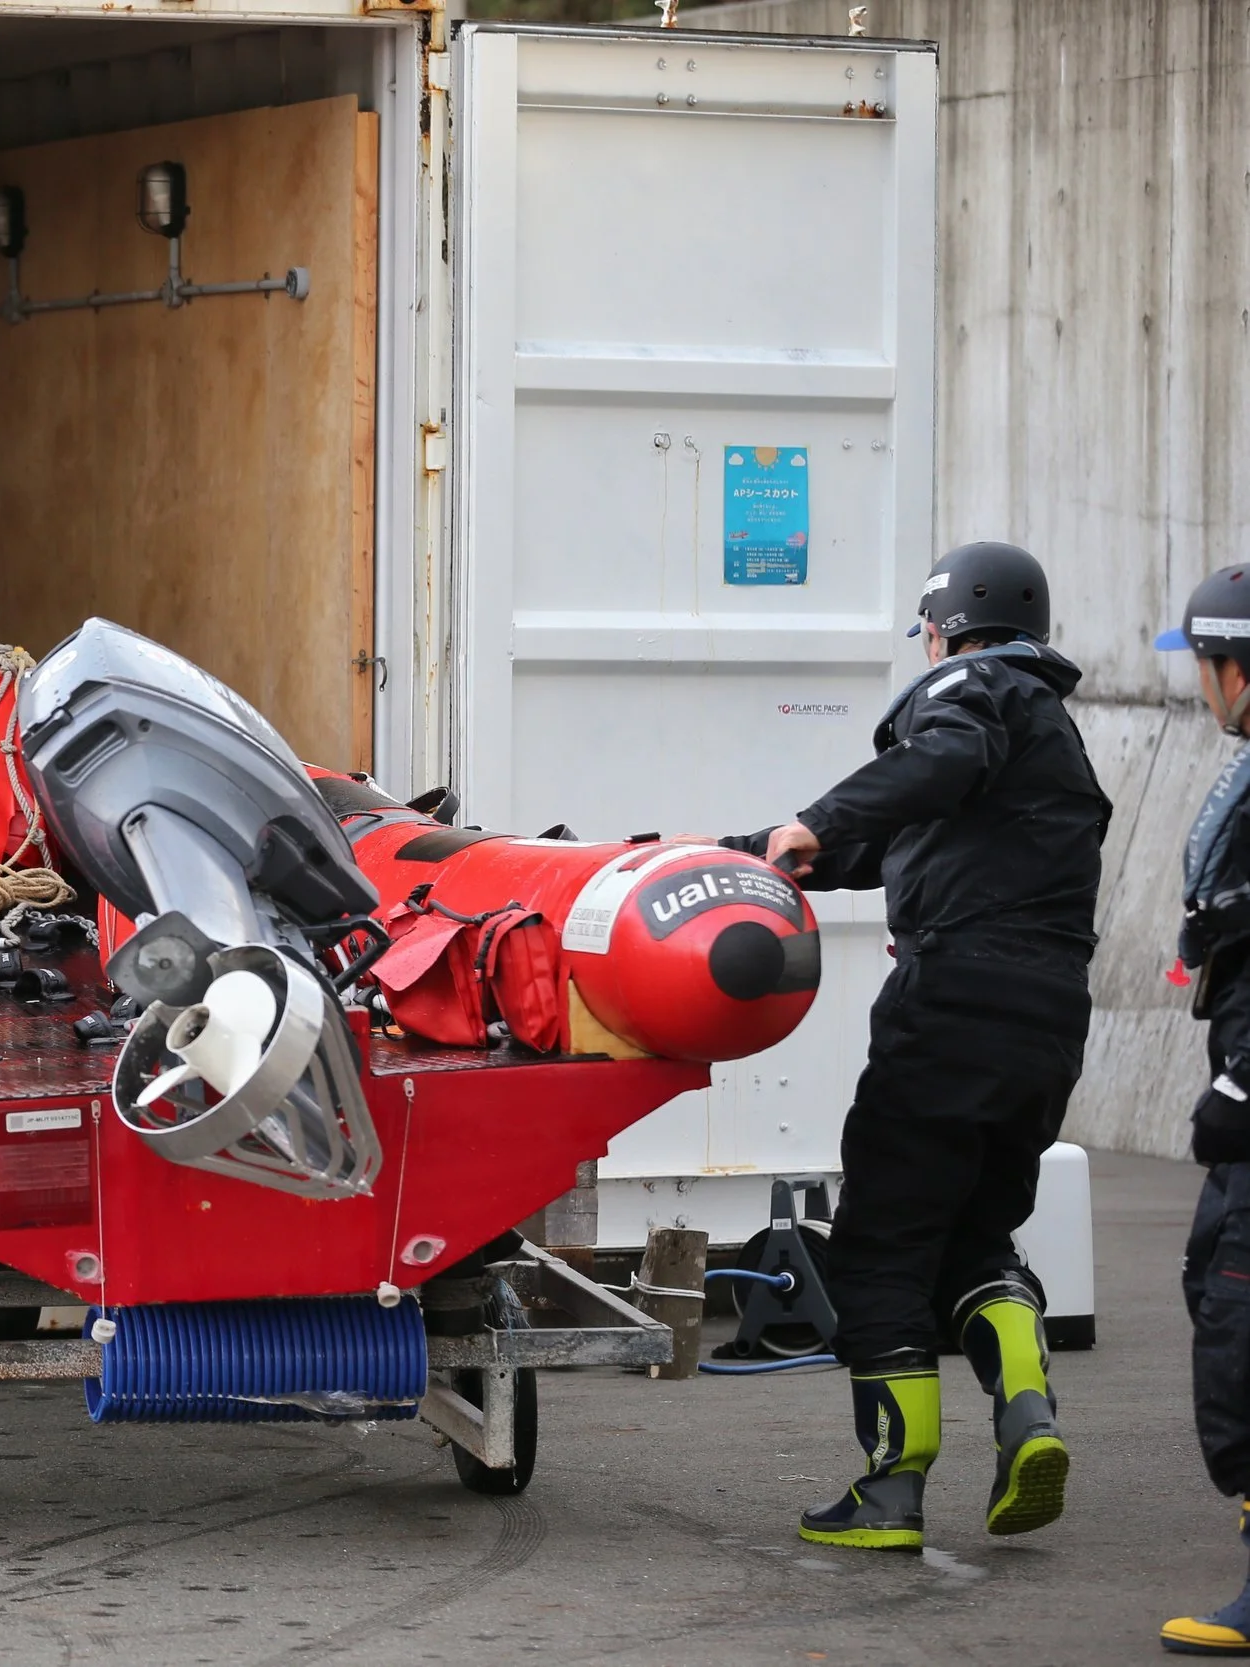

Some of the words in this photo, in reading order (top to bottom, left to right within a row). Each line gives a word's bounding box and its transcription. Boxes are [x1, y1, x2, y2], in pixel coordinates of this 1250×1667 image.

[733, 488, 799, 499] APシースカウト
[791, 704, 822, 712] ATLANTIC
[823, 704, 849, 713] PACIFIC
[735, 872, 793, 896] university
[754, 881, 775, 893] the
[652, 873, 734, 922] ual:
[742, 887, 785, 906] london
